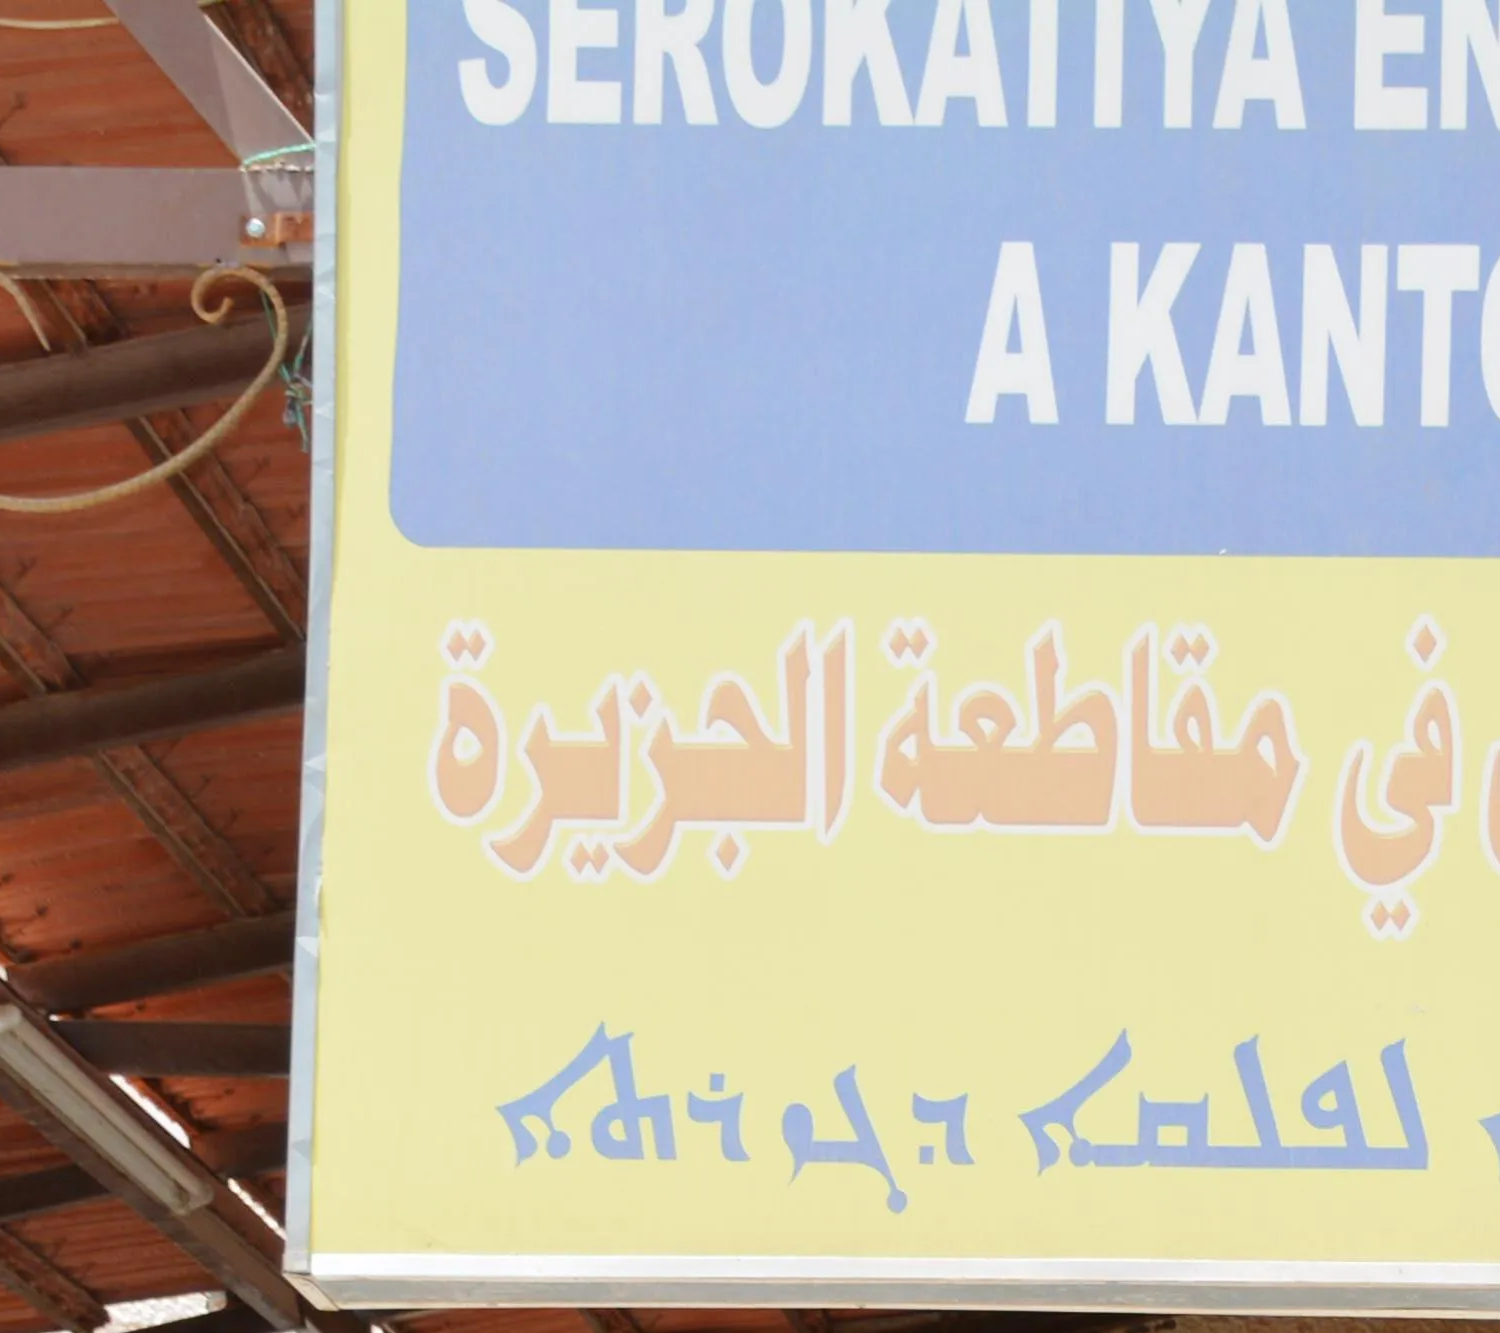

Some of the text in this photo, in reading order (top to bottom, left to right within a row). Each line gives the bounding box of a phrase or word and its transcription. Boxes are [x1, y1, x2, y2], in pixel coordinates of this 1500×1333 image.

[965, 241, 1060, 425] A
[431, 622, 852, 880] الجزيرة
[876, 622, 1306, 846] مقاطعة
[1338, 619, 1459, 936] في
